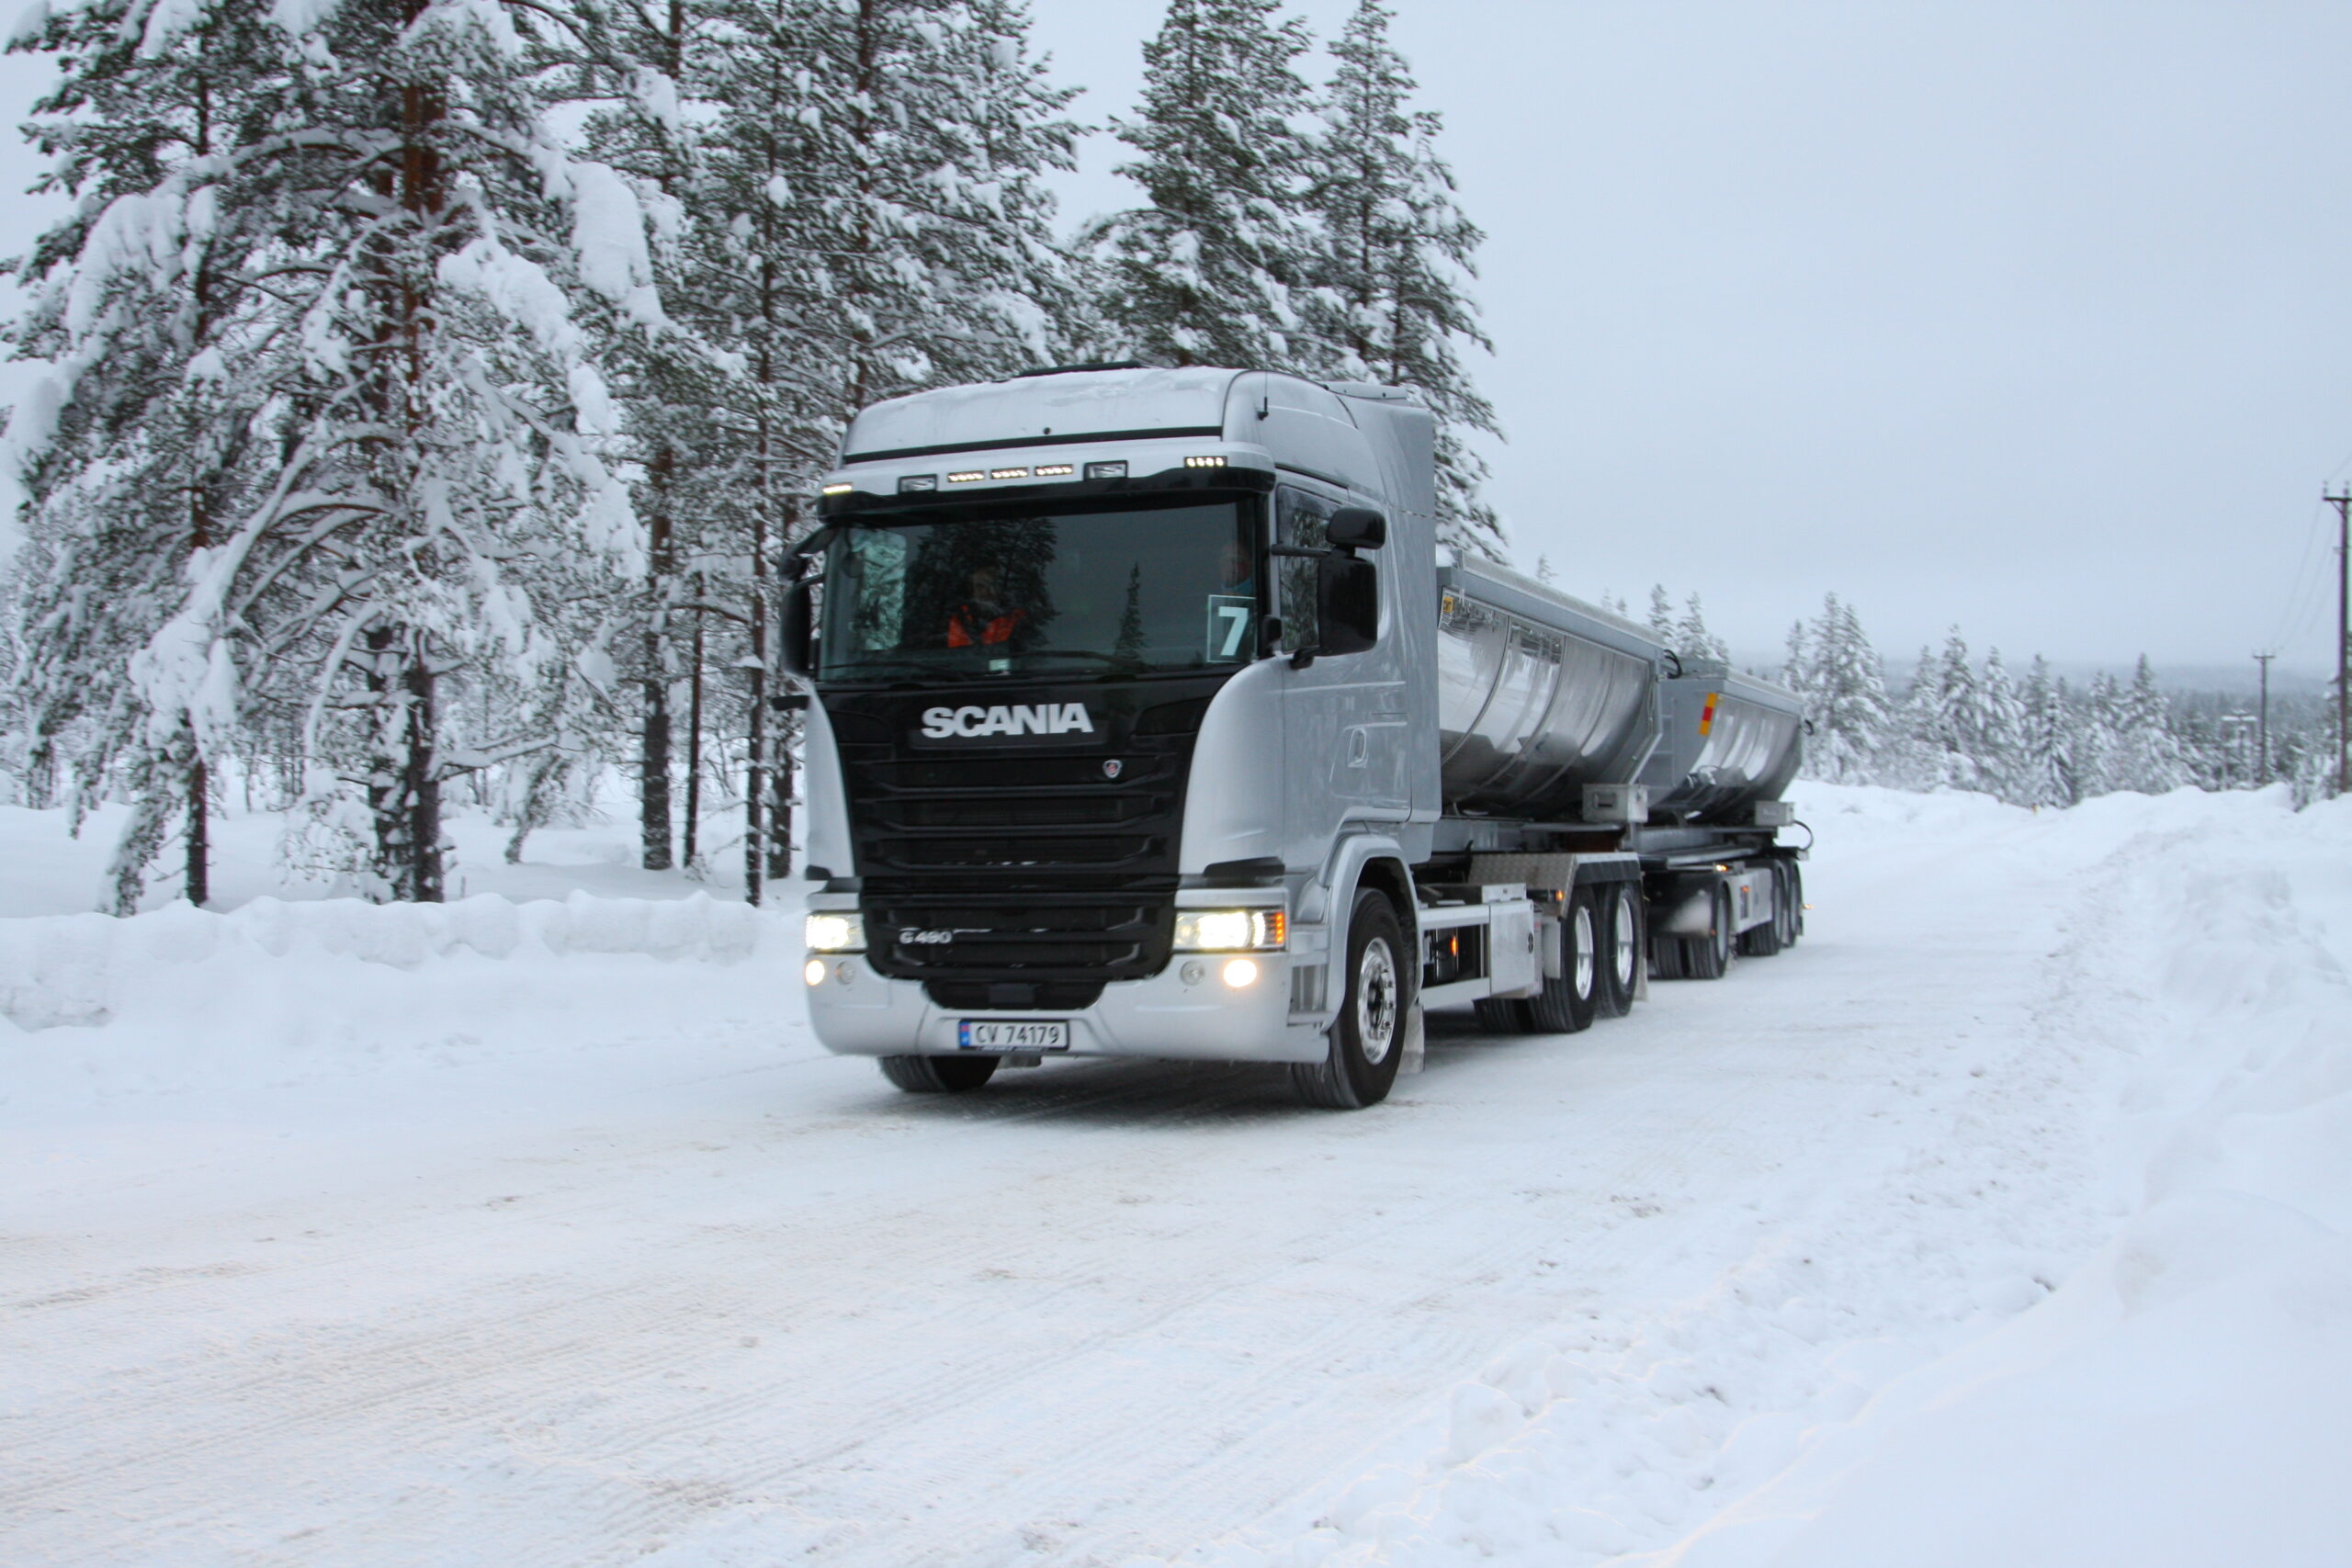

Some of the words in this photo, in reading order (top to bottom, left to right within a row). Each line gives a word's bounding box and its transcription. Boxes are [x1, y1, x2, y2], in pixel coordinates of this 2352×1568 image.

[1218, 606, 1249, 656] 7
[922, 703, 1094, 739] SCANIA
[976, 1025, 999, 1043] CV
[1005, 1025, 1059, 1044] 74179
